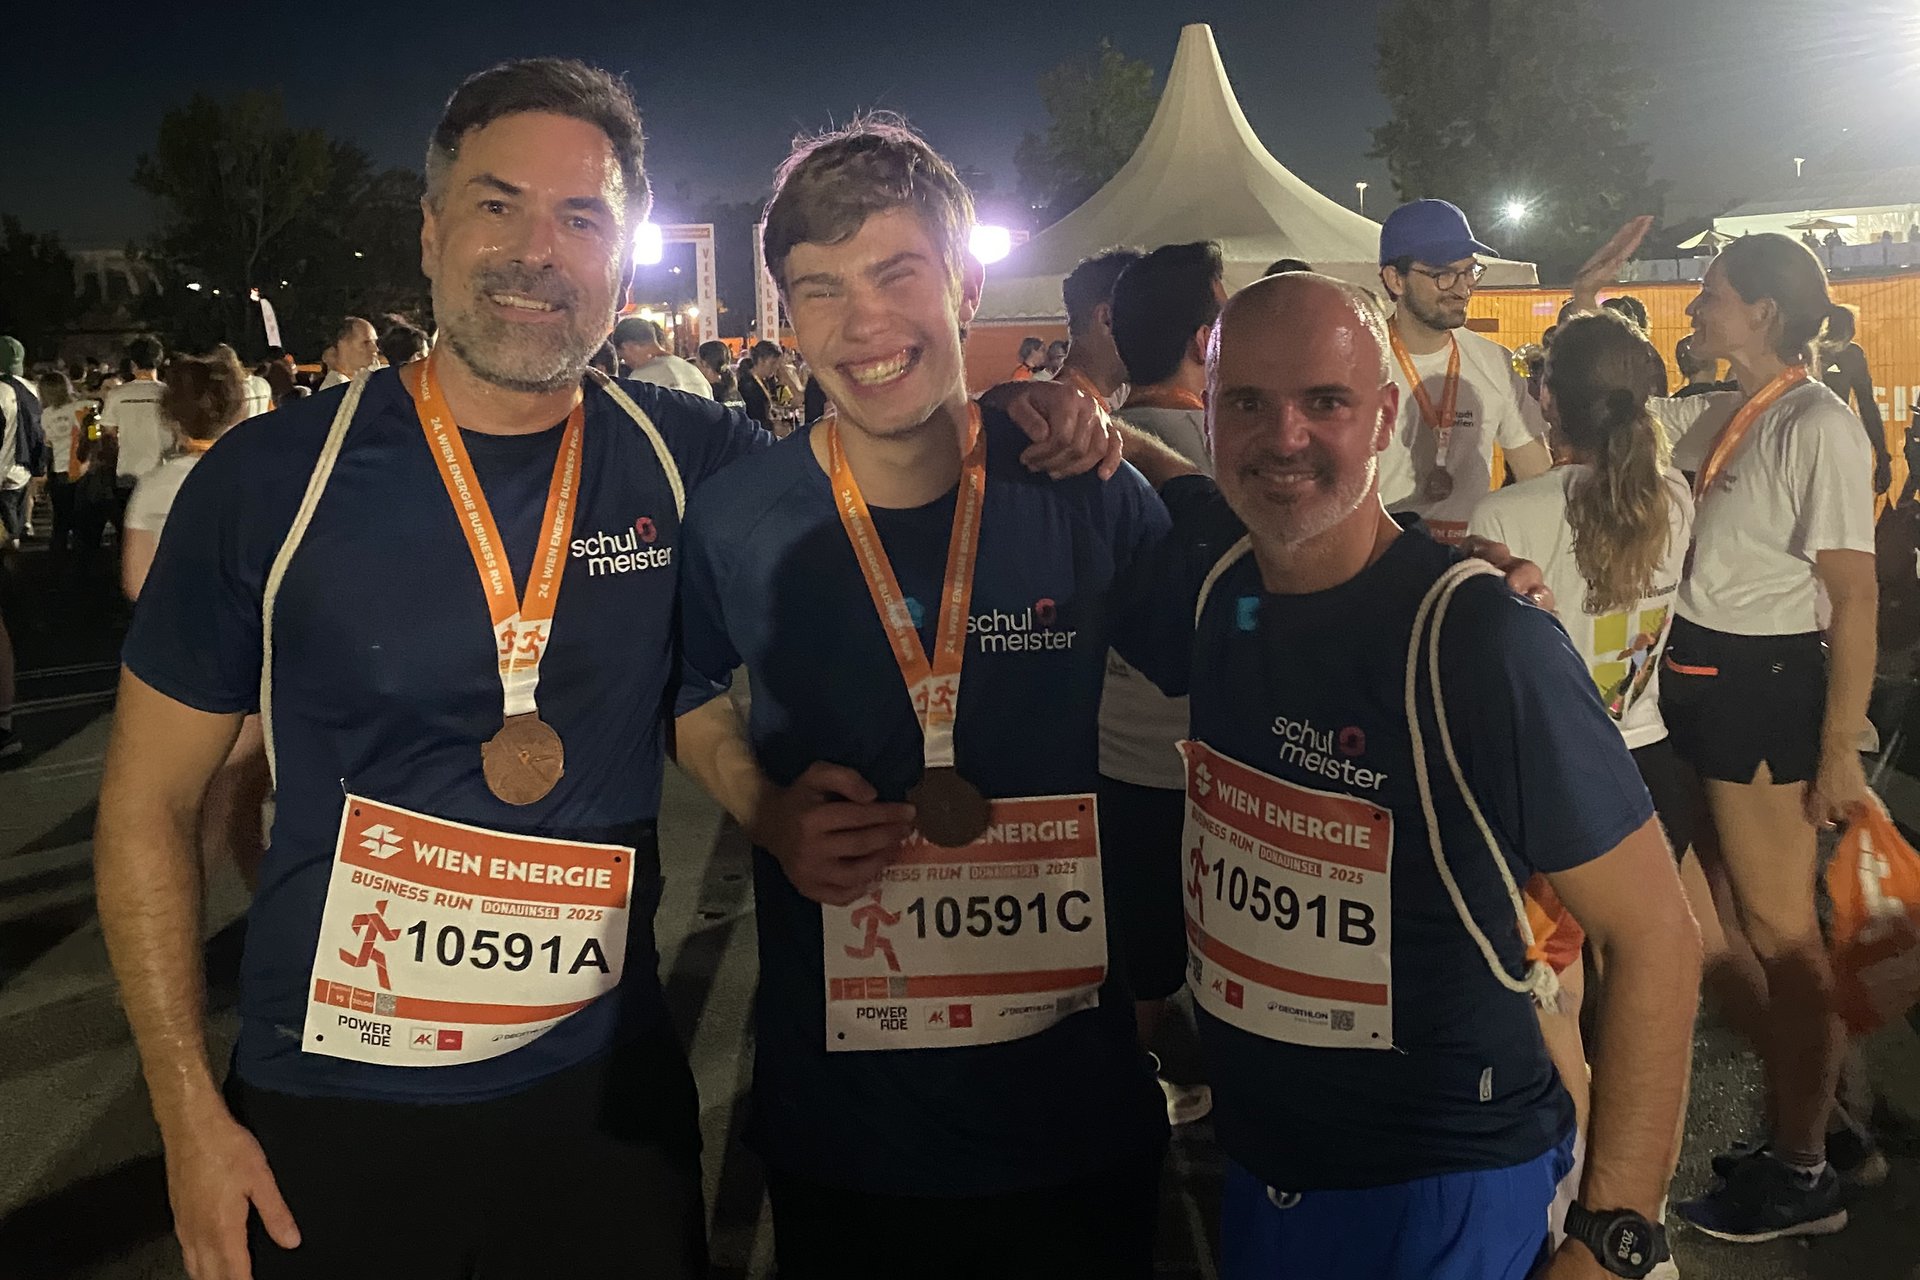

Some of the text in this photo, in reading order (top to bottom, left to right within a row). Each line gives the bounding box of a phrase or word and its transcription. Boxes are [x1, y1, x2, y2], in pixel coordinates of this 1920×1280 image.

[430, 417, 505, 597] 24. WIEN ENERGIE BUSINESS RUN
[542, 547, 558, 578] WIEN
[550, 498, 568, 547] ENERGIE
[571, 527, 637, 558] schul
[588, 546, 672, 577] meister
[967, 607, 1032, 633] schul
[980, 627, 1076, 653] meister
[1271, 716, 1335, 755] schul
[1279, 741, 1388, 790] meister
[1217, 779, 1371, 849] WIEN ENERGIE
[413, 840, 612, 889] WIEN ENERGIE
[927, 865, 962, 882] RUN
[1045, 862, 1077, 876] 2025
[1229, 830, 1254, 853] RUN
[1260, 847, 1321, 876] DONAUINSEL
[1329, 866, 1364, 885] 2025
[351, 870, 603, 922] BUSINESS RUN DONAUINSEL 2025
[1212, 857, 1377, 947] 10591B
[907, 889, 1092, 939] 10591C
[407, 919, 610, 975] 10591A
[338, 1014, 392, 1036] POWER
[856, 1006, 908, 1020] POWER
[880, 1018, 908, 1031] ADE
[928, 1010, 944, 1024] AK
[360, 1032, 391, 1047] ADE
[413, 1033, 433, 1046] AK
